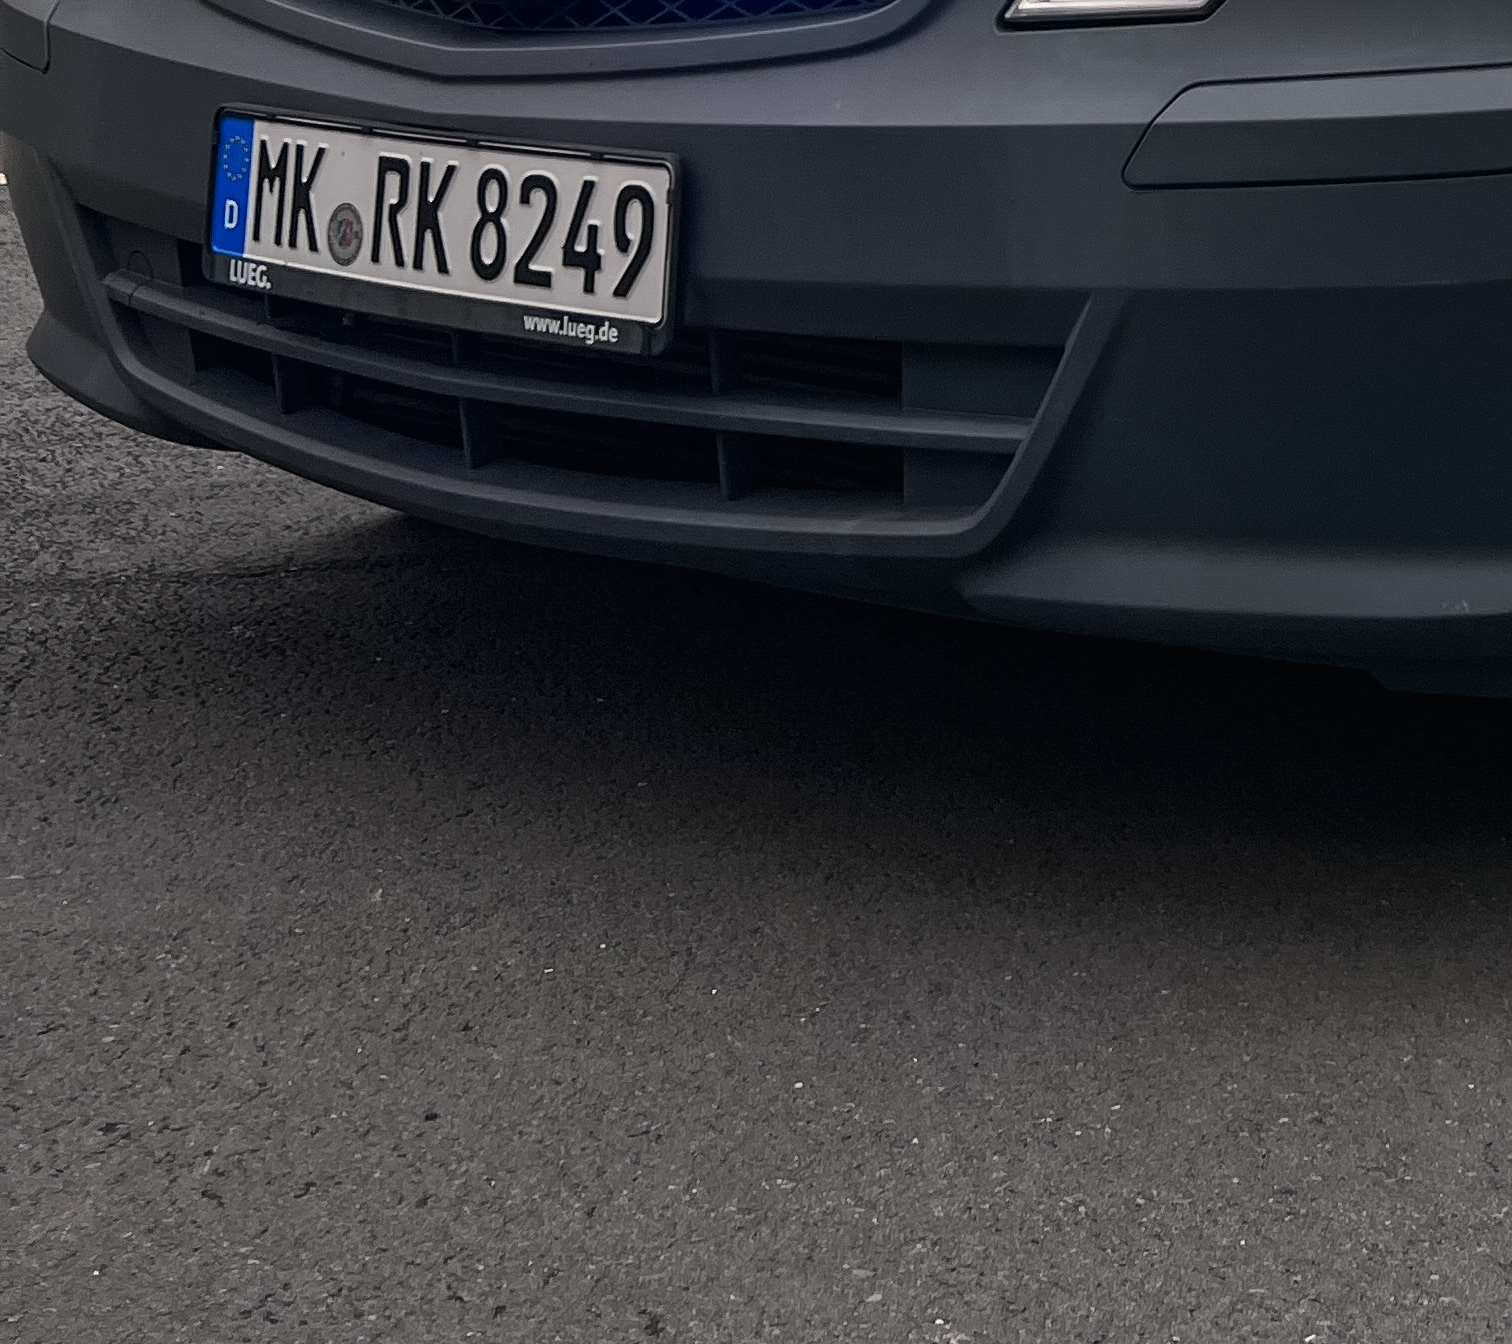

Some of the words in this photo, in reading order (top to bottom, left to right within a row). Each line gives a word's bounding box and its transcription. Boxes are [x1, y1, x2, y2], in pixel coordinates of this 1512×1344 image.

[224, 200, 238, 230] D
[252, 139, 328, 254] MK
[370, 154, 459, 276] RK
[470, 167, 656, 299] 8249
[523, 314, 620, 346] www.lueg.de
